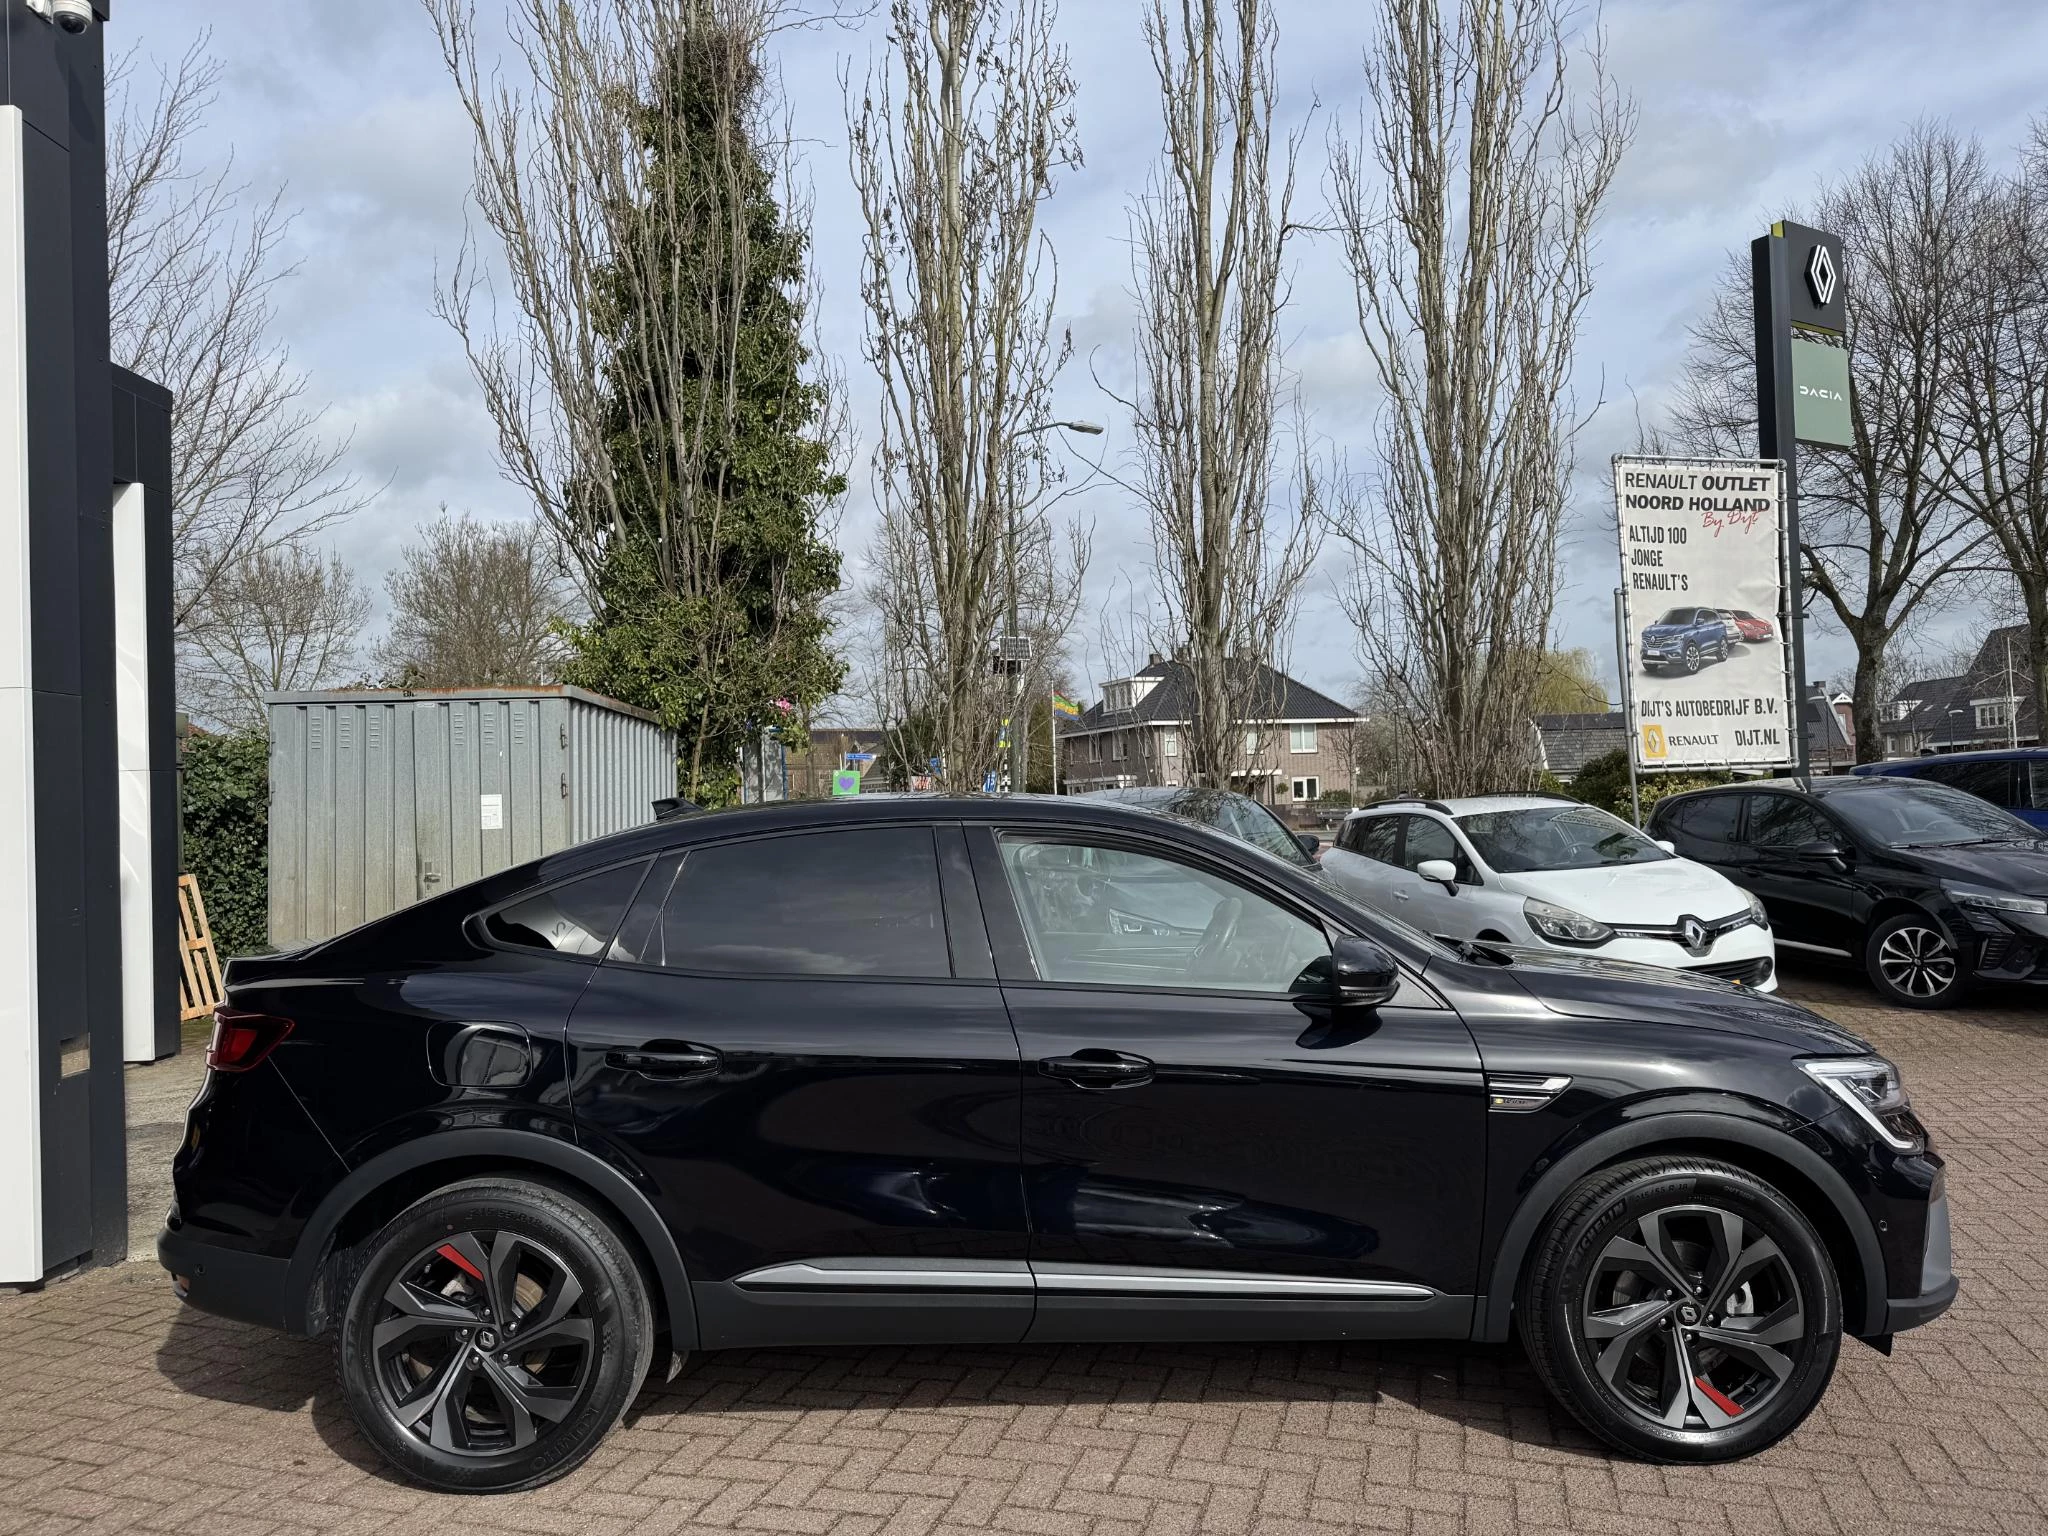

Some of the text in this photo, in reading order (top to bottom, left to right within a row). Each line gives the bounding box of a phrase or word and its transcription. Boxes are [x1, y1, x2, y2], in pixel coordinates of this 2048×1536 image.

[1799, 385, 1843, 401] DACIA
[1625, 472, 1771, 492] RENAULT OUTLET
[1625, 494, 1771, 512] NOORD HOLLAND
[1629, 525, 1687, 545] ALTIJD 100
[1631, 548, 1664, 568] JONGE
[1632, 572, 1689, 592] RENAULT'S
[1641, 697, 1778, 718] DIJT'S AUTOBEDRIJF B.V.
[1668, 728, 1780, 747] RENAULT DIJT.NL
